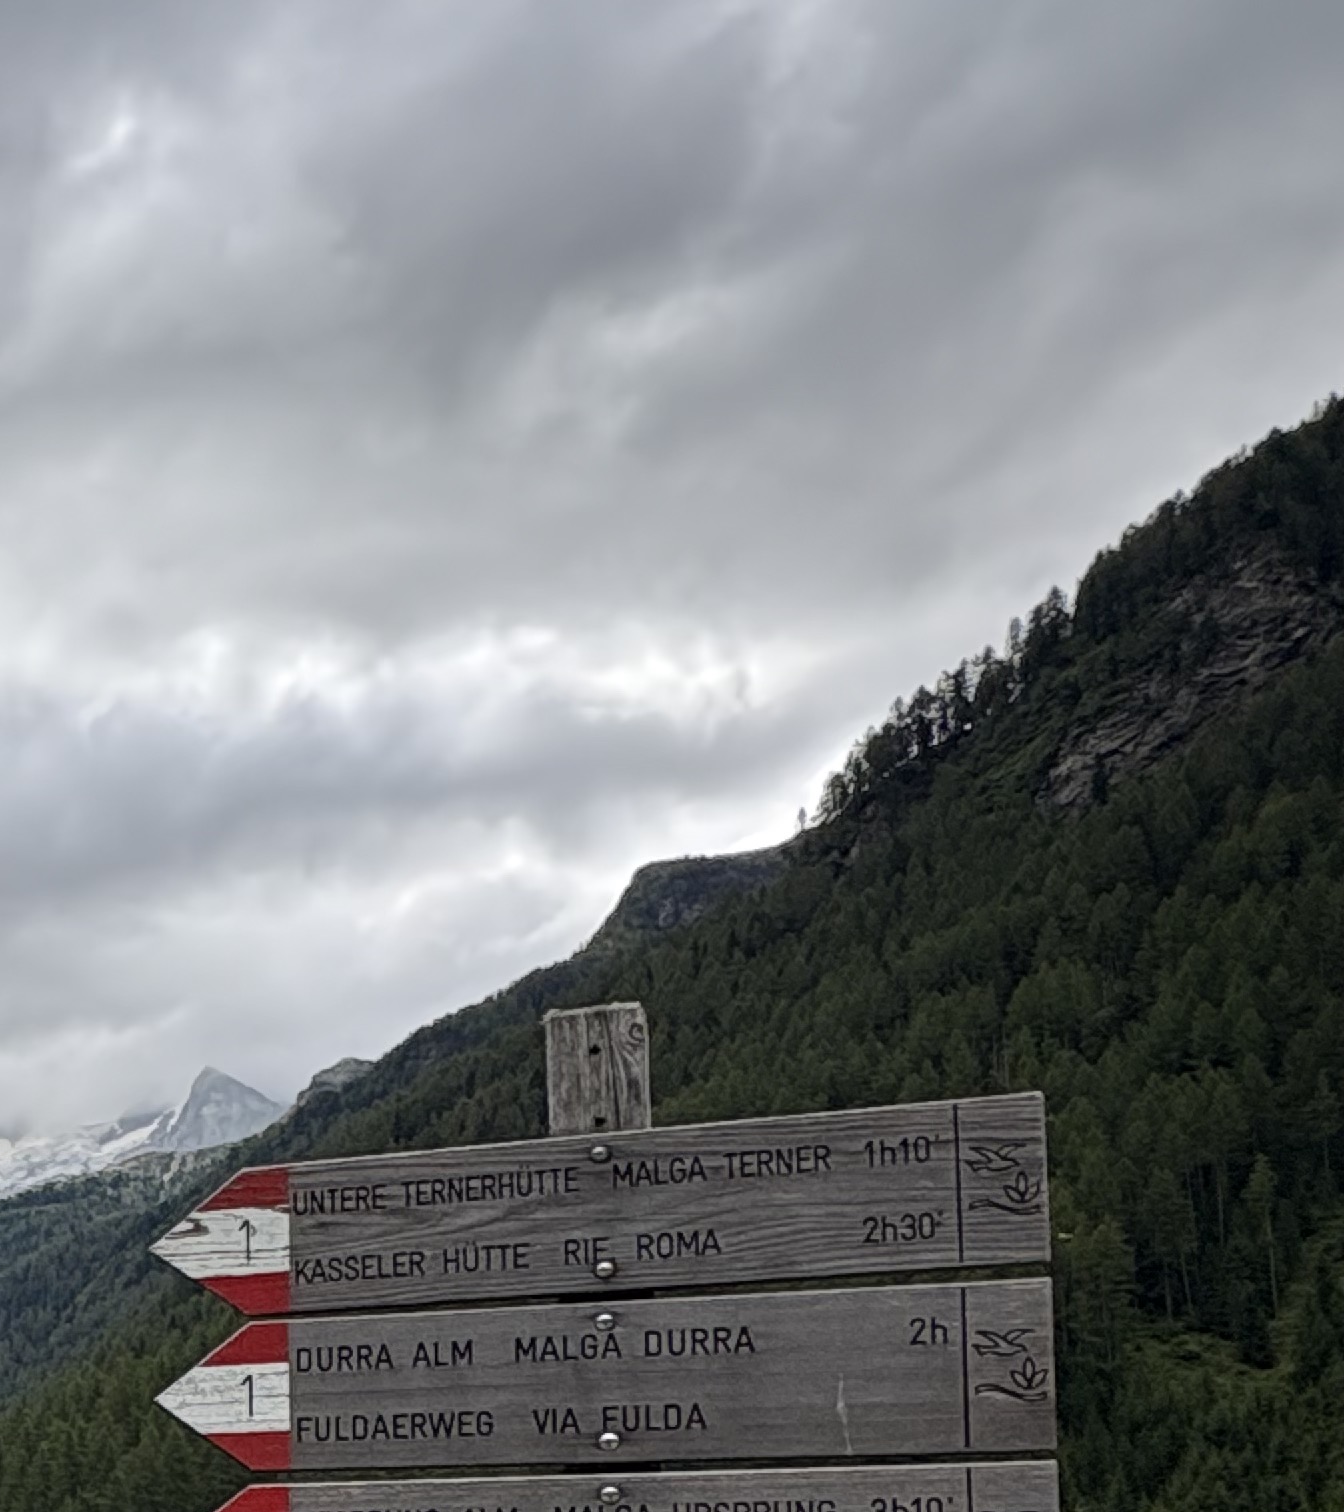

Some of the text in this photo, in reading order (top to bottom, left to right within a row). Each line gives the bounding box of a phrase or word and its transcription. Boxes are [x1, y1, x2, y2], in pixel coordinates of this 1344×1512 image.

[293, 1184, 389, 1215] UNTERE
[402, 1166, 581, 1208] TERNERHÜTTE
[612, 1157, 708, 1188] MALGA
[723, 1145, 832, 1180] TERNER
[238, 1219, 251, 1264] 1
[295, 1251, 426, 1285] KASSELER
[443, 1242, 531, 1274] HÜTTE
[636, 1228, 722, 1261] ROMA
[296, 1316, 949, 1373] DURRA ALM MALGA DURRA 2h
[239, 1374, 254, 1418] 1
[296, 1403, 708, 1443] FULDAERWEG VIA FULDA
